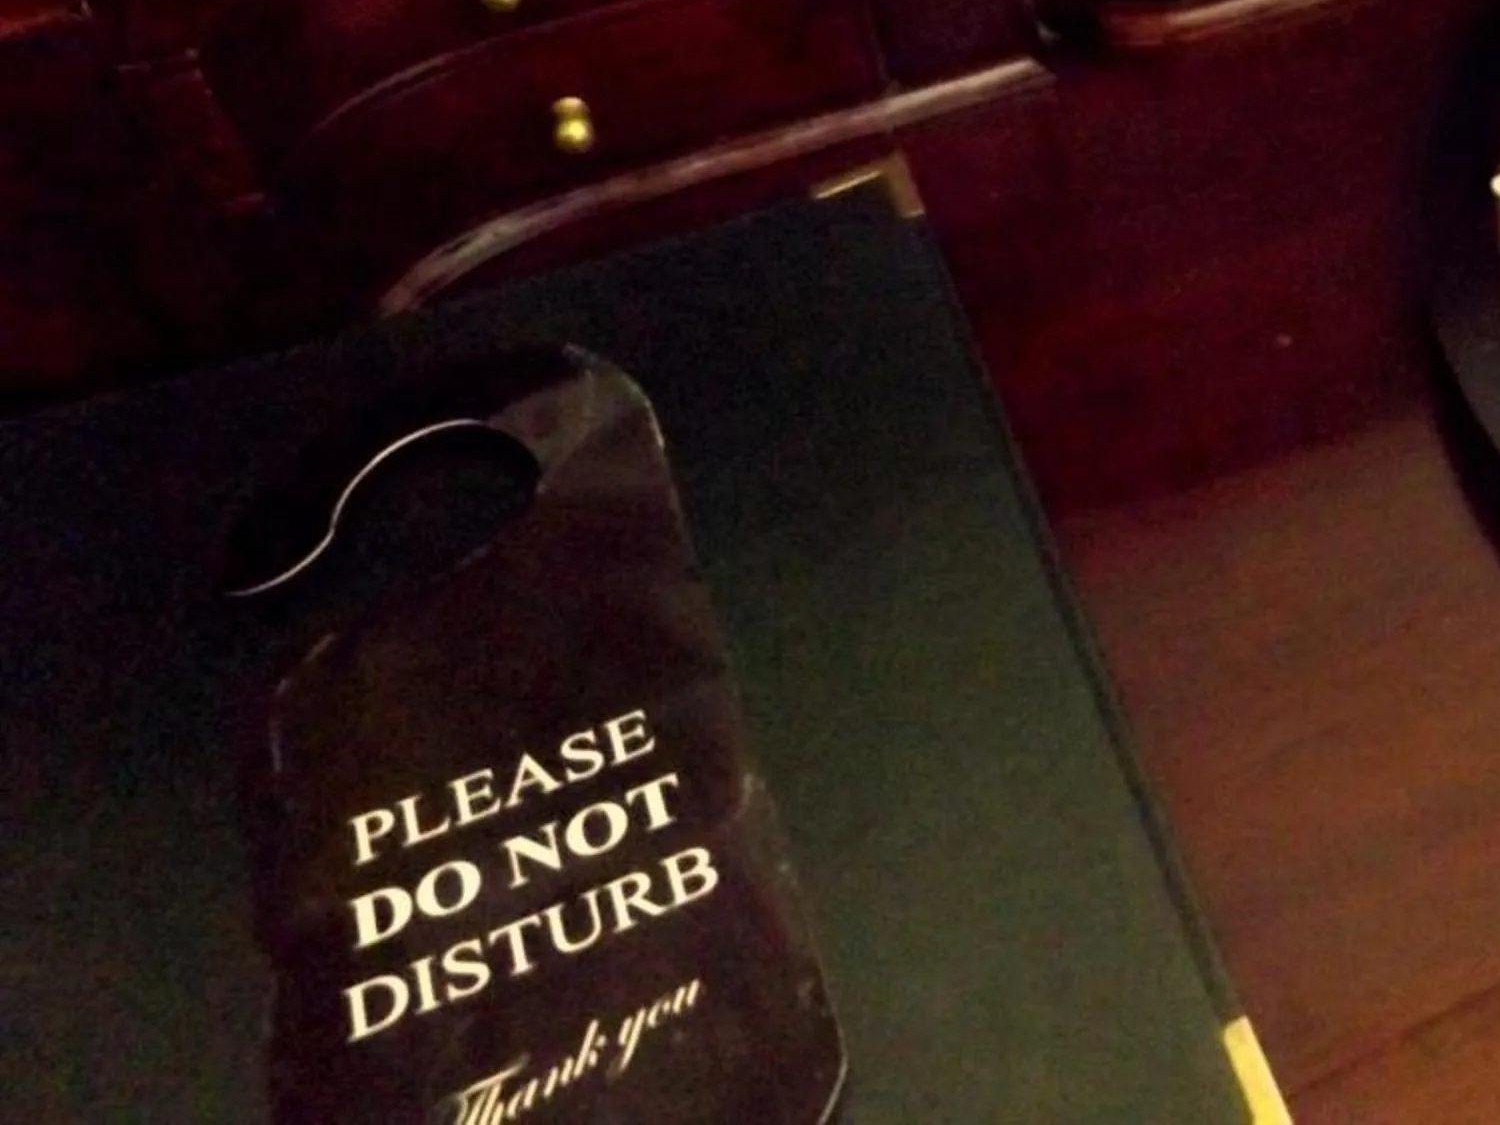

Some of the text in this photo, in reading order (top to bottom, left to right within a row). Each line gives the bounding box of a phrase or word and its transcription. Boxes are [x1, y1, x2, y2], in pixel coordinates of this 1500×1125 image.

[349, 708, 656, 866] PLEASE
[349, 773, 679, 949] DO NOT
[343, 845, 720, 1042] DISTURB
[454, 978, 701, 1125] Thank you
